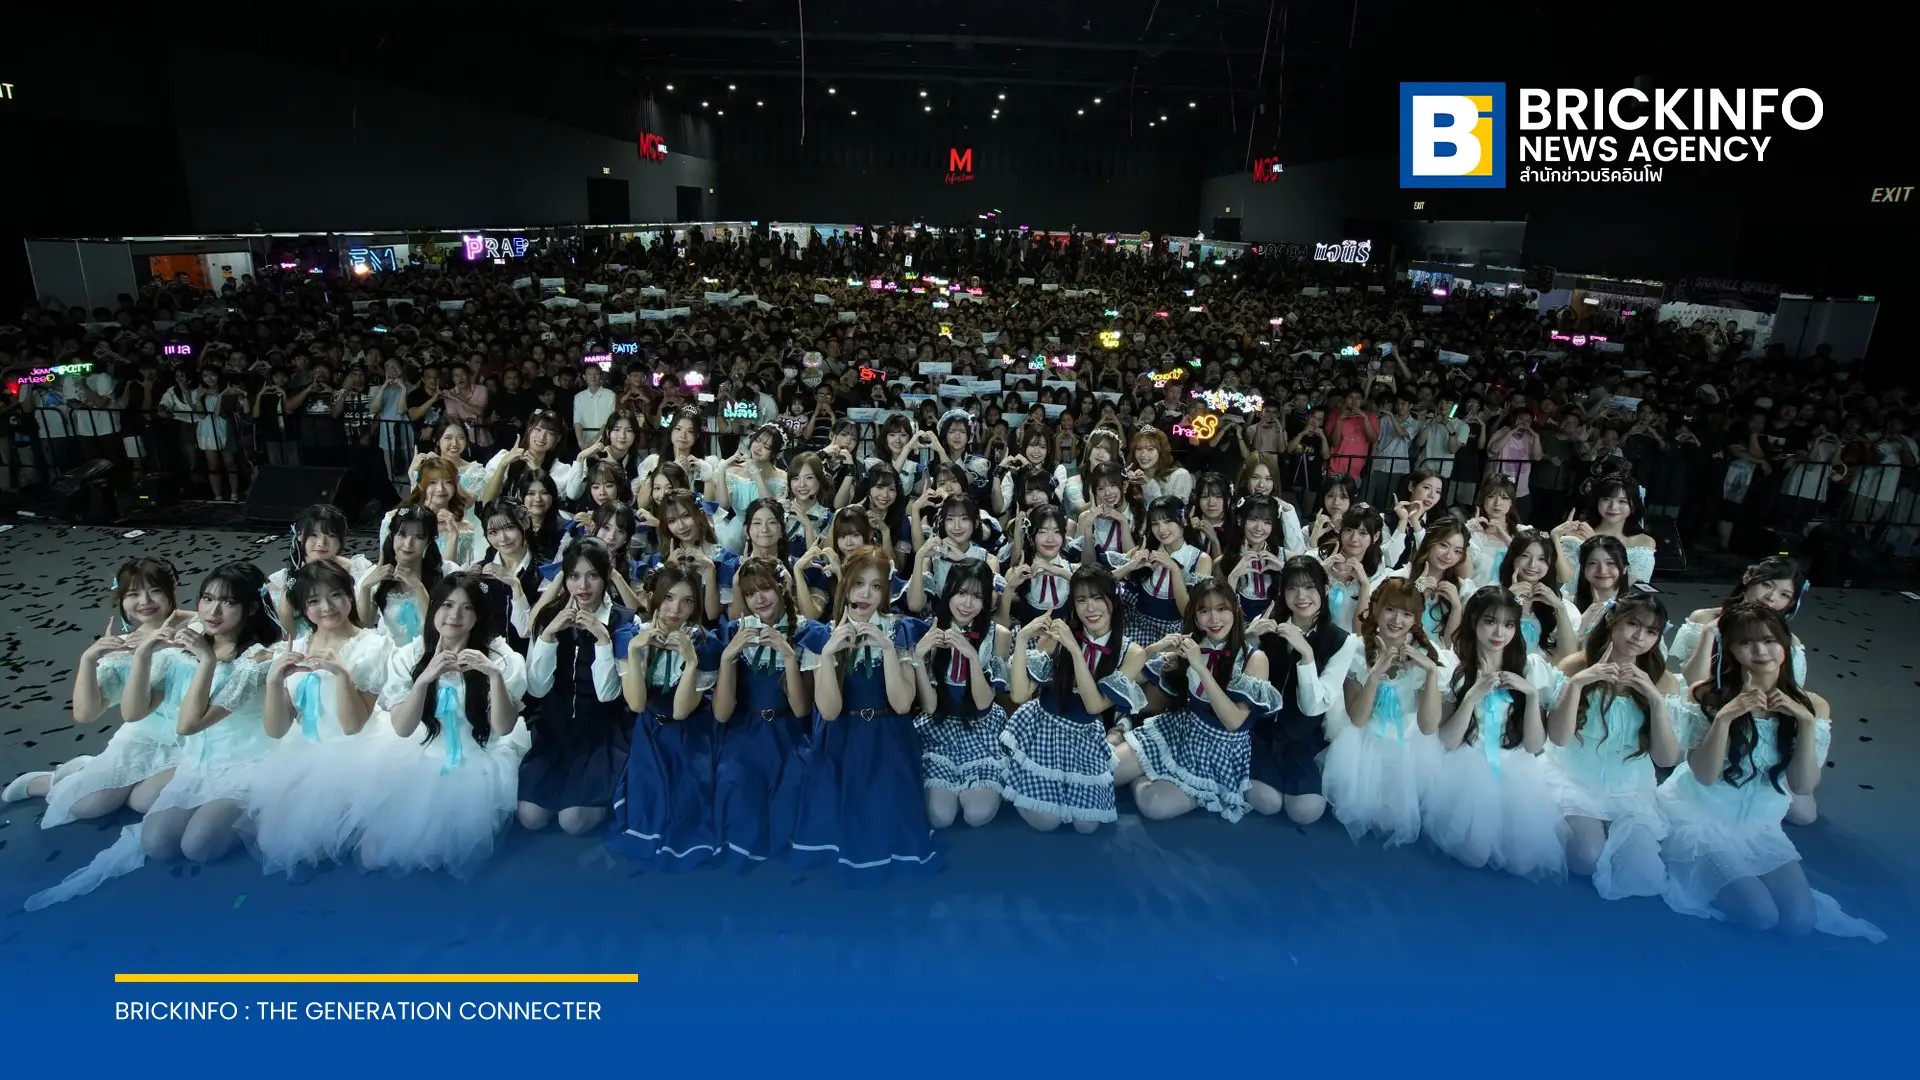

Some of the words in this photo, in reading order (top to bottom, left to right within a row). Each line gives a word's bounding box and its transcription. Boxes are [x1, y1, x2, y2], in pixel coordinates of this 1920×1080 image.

[950, 148, 972, 172] M
[1871, 186, 1915, 202] EXIT
[1414, 201, 1425, 210] EXIT
[463, 236, 524, 260] PRAE
